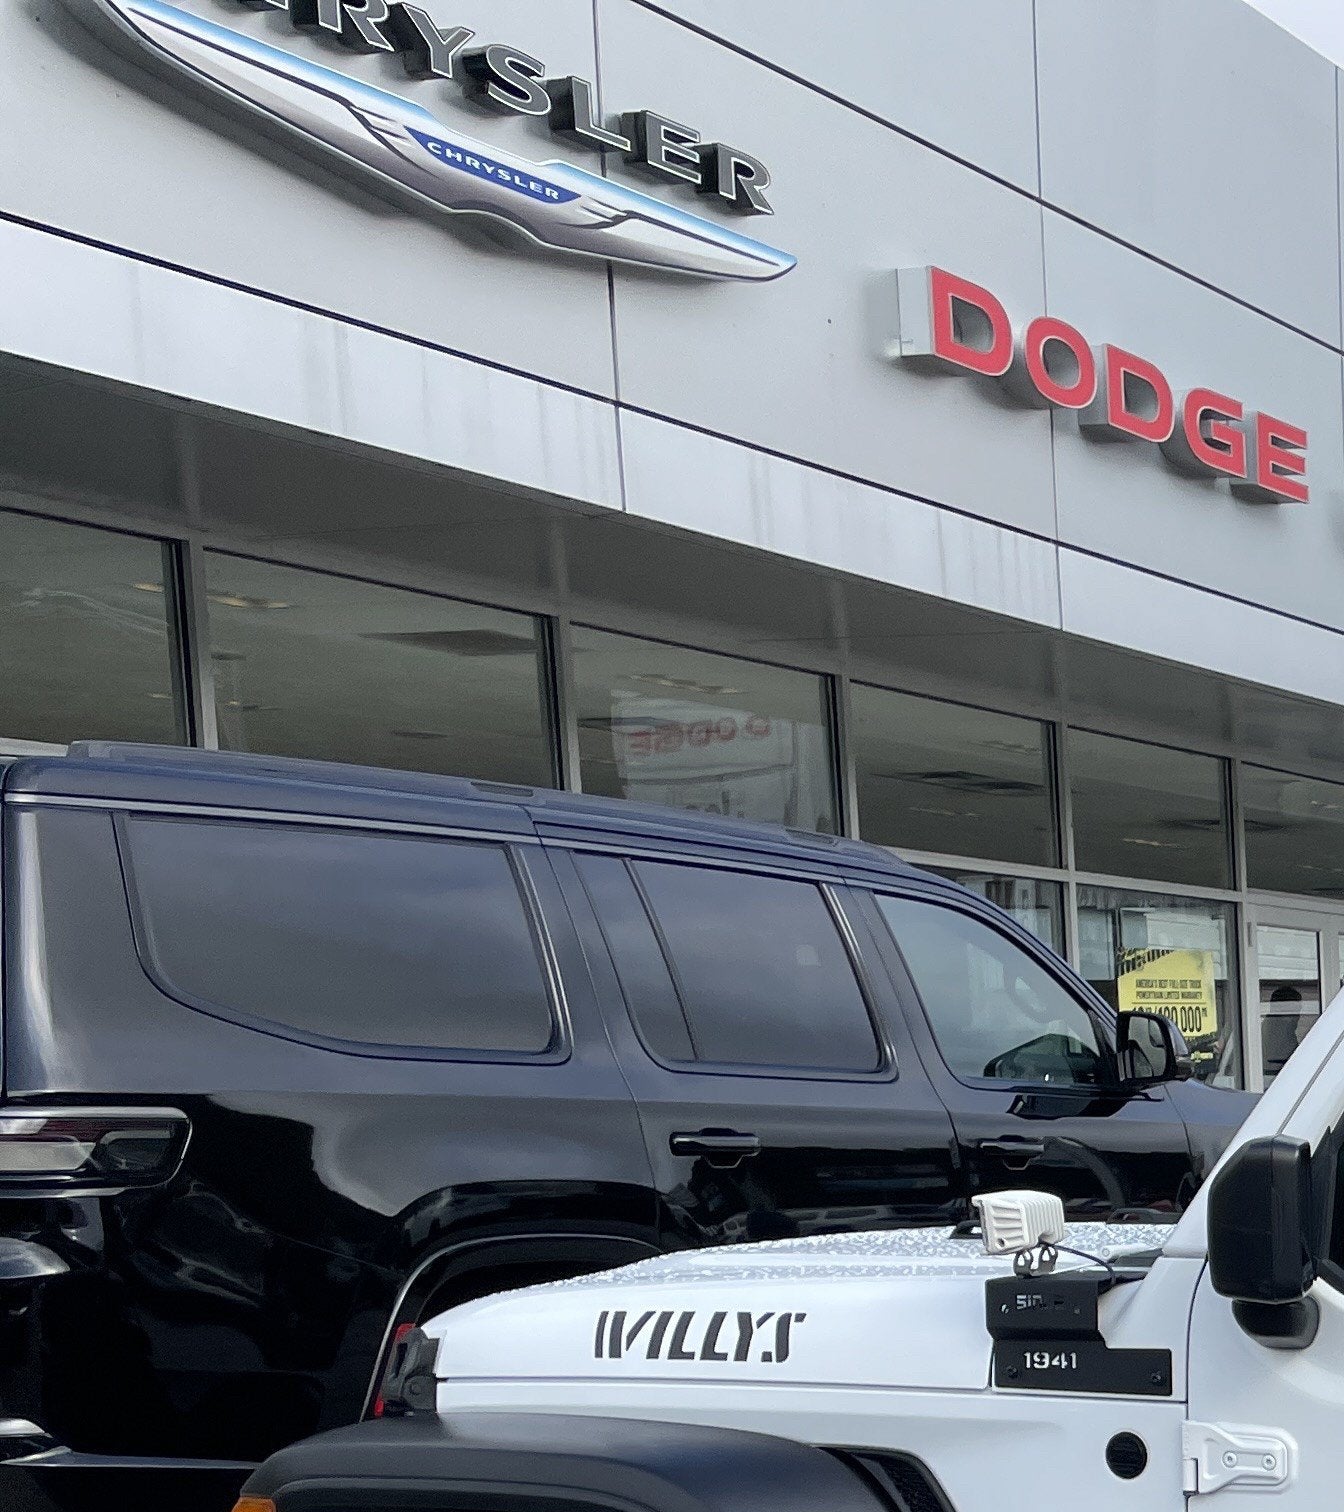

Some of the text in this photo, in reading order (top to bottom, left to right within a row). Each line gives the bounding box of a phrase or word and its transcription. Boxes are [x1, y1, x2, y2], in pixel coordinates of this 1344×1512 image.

[265, 0, 775, 215] RYSLER
[427, 141, 559, 200] CHRYSLER
[928, 264, 1310, 504] DODGE
[593, 1310, 807, 1363] WILLYS
[1024, 1352, 1078, 1370] 1941
